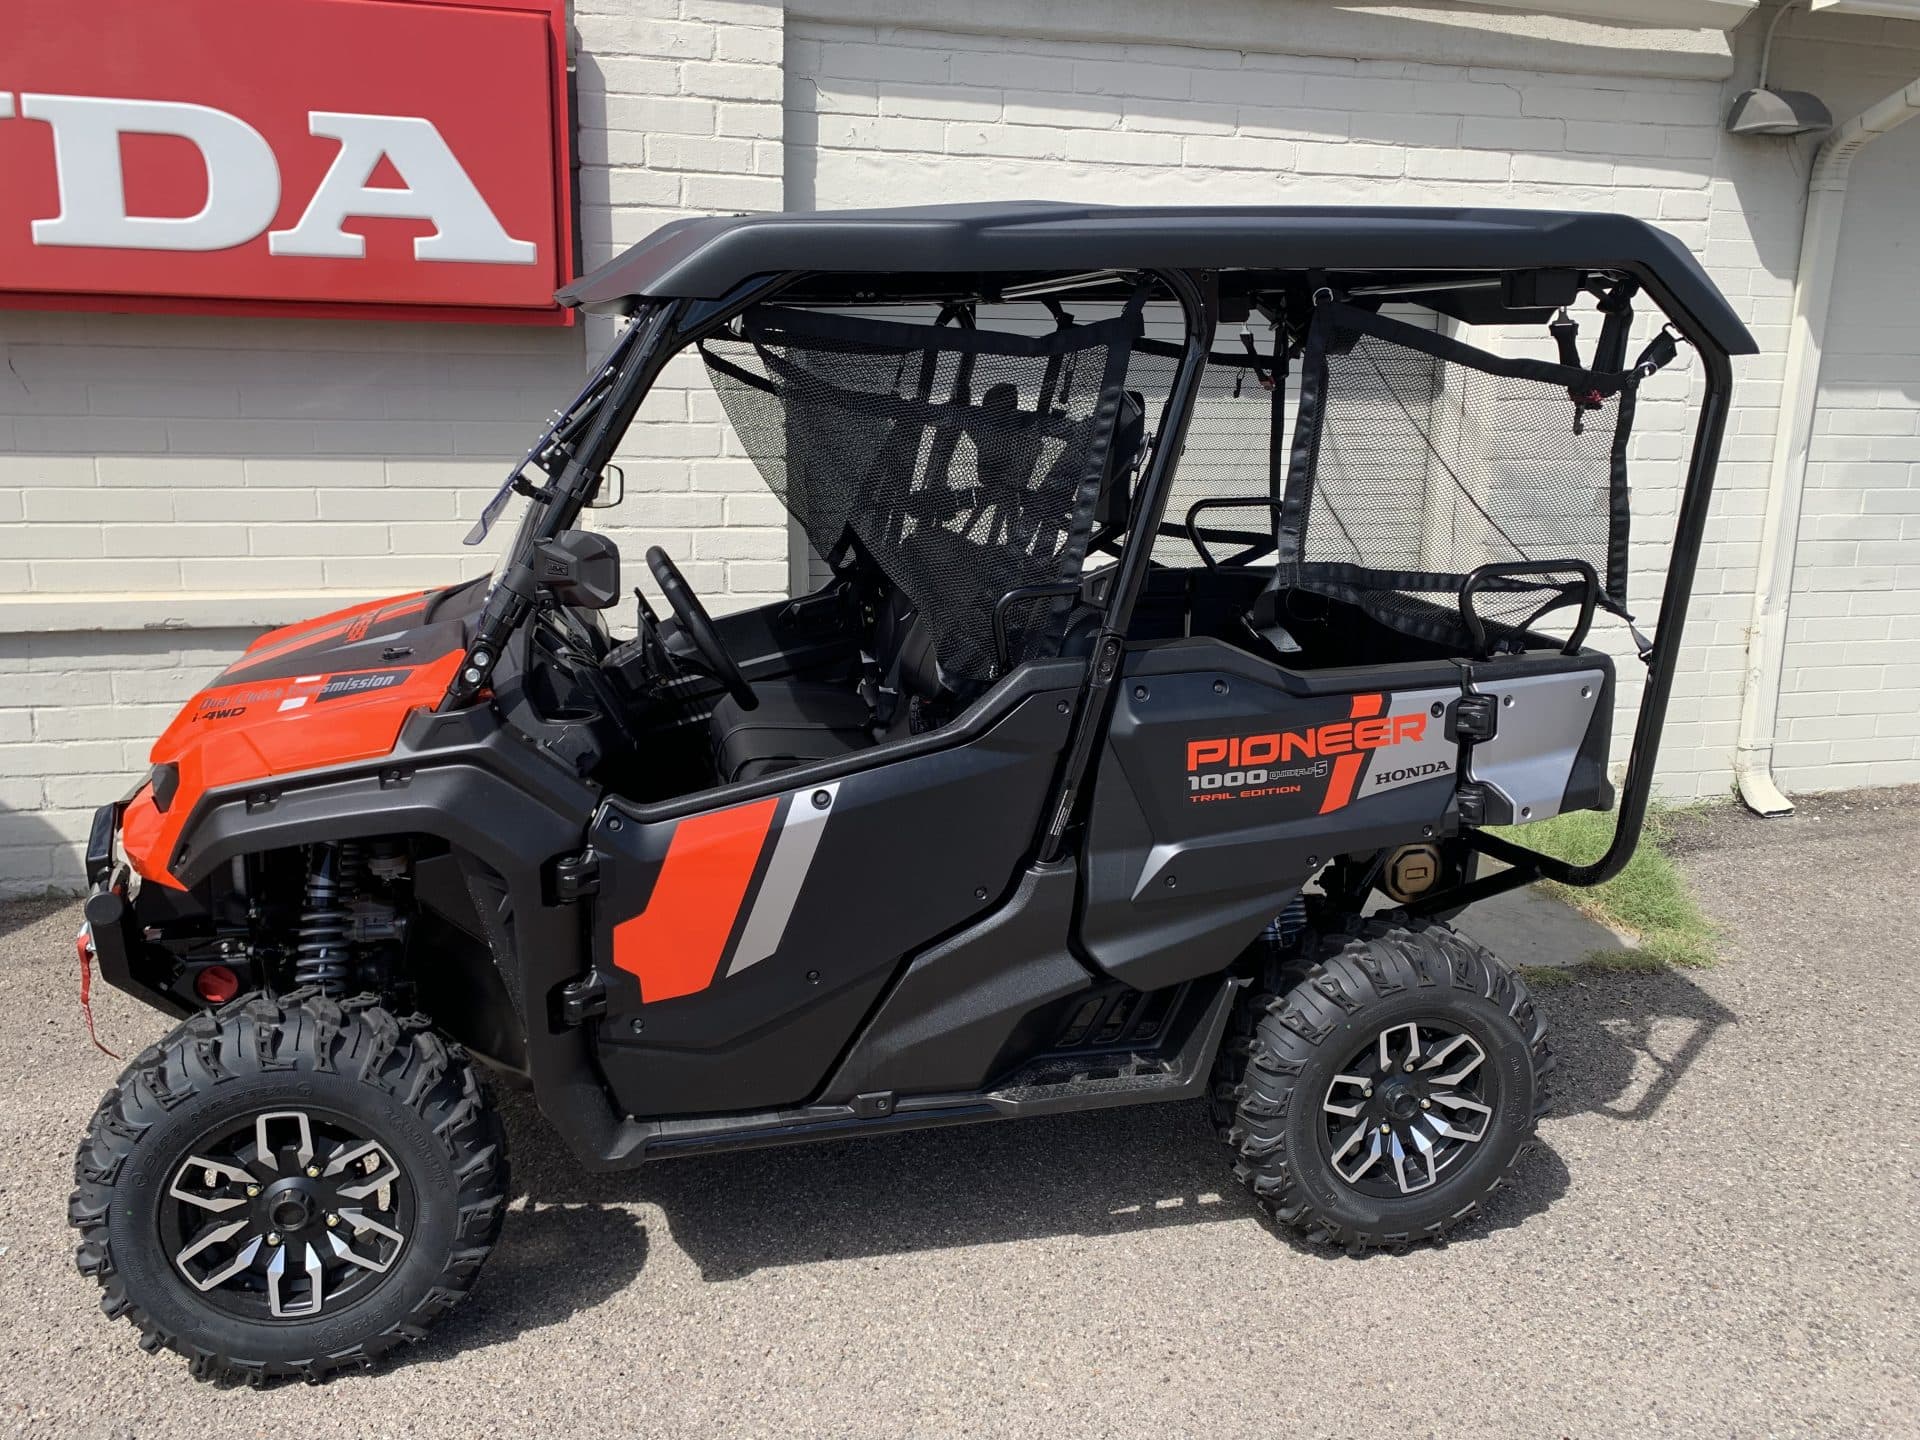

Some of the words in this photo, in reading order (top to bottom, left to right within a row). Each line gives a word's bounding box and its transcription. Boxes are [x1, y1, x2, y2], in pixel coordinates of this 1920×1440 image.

[0, 92, 537, 264] DA
[1187, 713, 1427, 771] PIONEER
[1188, 769, 1268, 790] 1000
[1375, 760, 1451, 785] HONDA
[1190, 793, 1237, 803] TRAIL
[1240, 785, 1302, 798] EDITION
